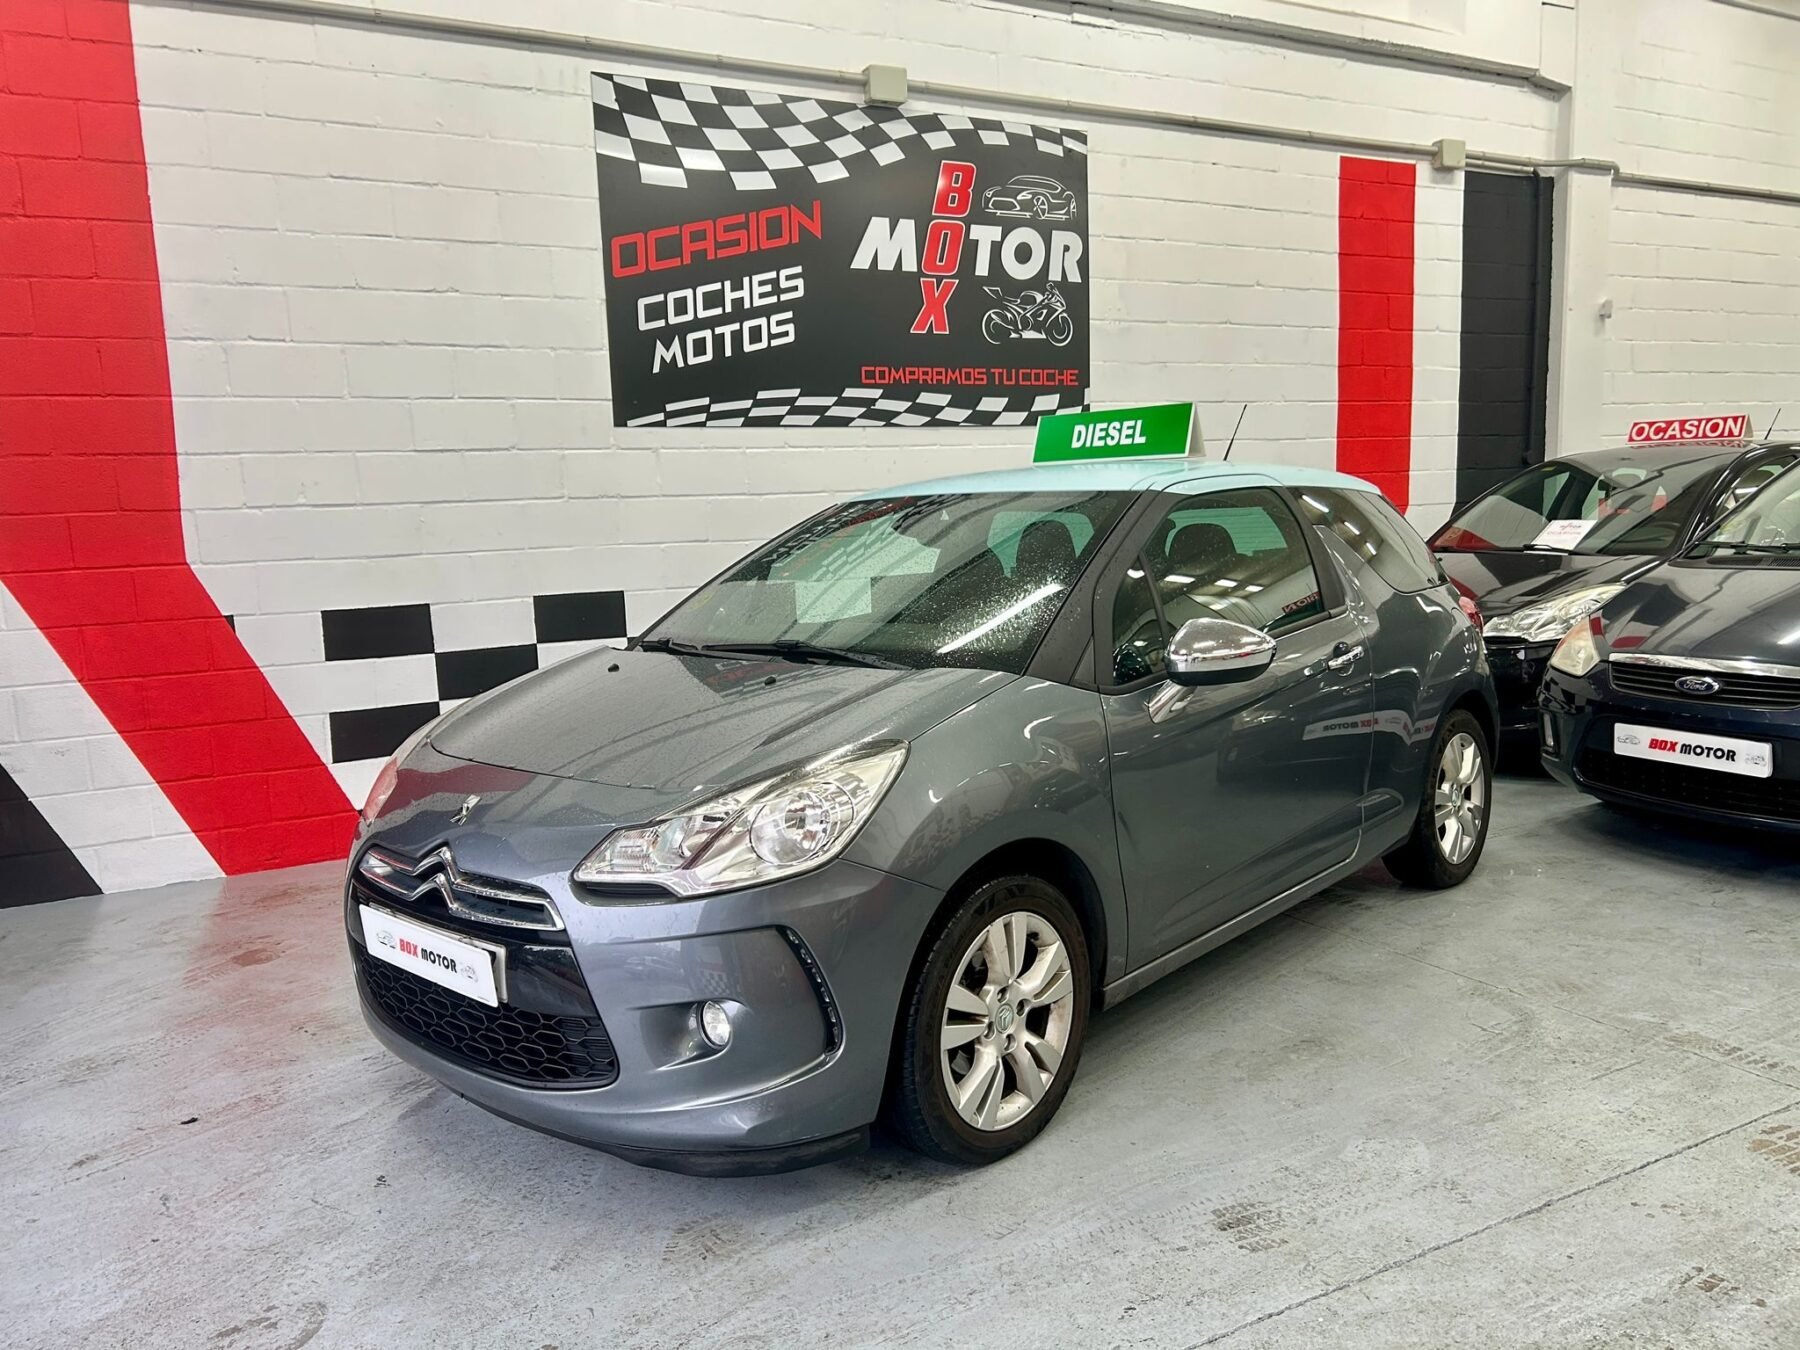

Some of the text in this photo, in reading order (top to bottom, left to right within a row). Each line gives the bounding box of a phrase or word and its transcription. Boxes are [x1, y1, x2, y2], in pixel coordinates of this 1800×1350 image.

[612, 200, 823, 278] OCASION
[850, 216, 1083, 283] MOTOR
[910, 160, 976, 334] BOX
[637, 265, 805, 331] COCHES
[652, 311, 796, 374] MOTOS
[861, 366, 1079, 386] COMPRAMOS TU COCHE
[1071, 420, 1146, 449] DIESEL
[1632, 418, 1742, 440] OCASION
[1684, 679, 1707, 690] Ford
[1648, 738, 1737, 762] BOX MOTOR
[399, 938, 457, 973] BOX MOTOR
